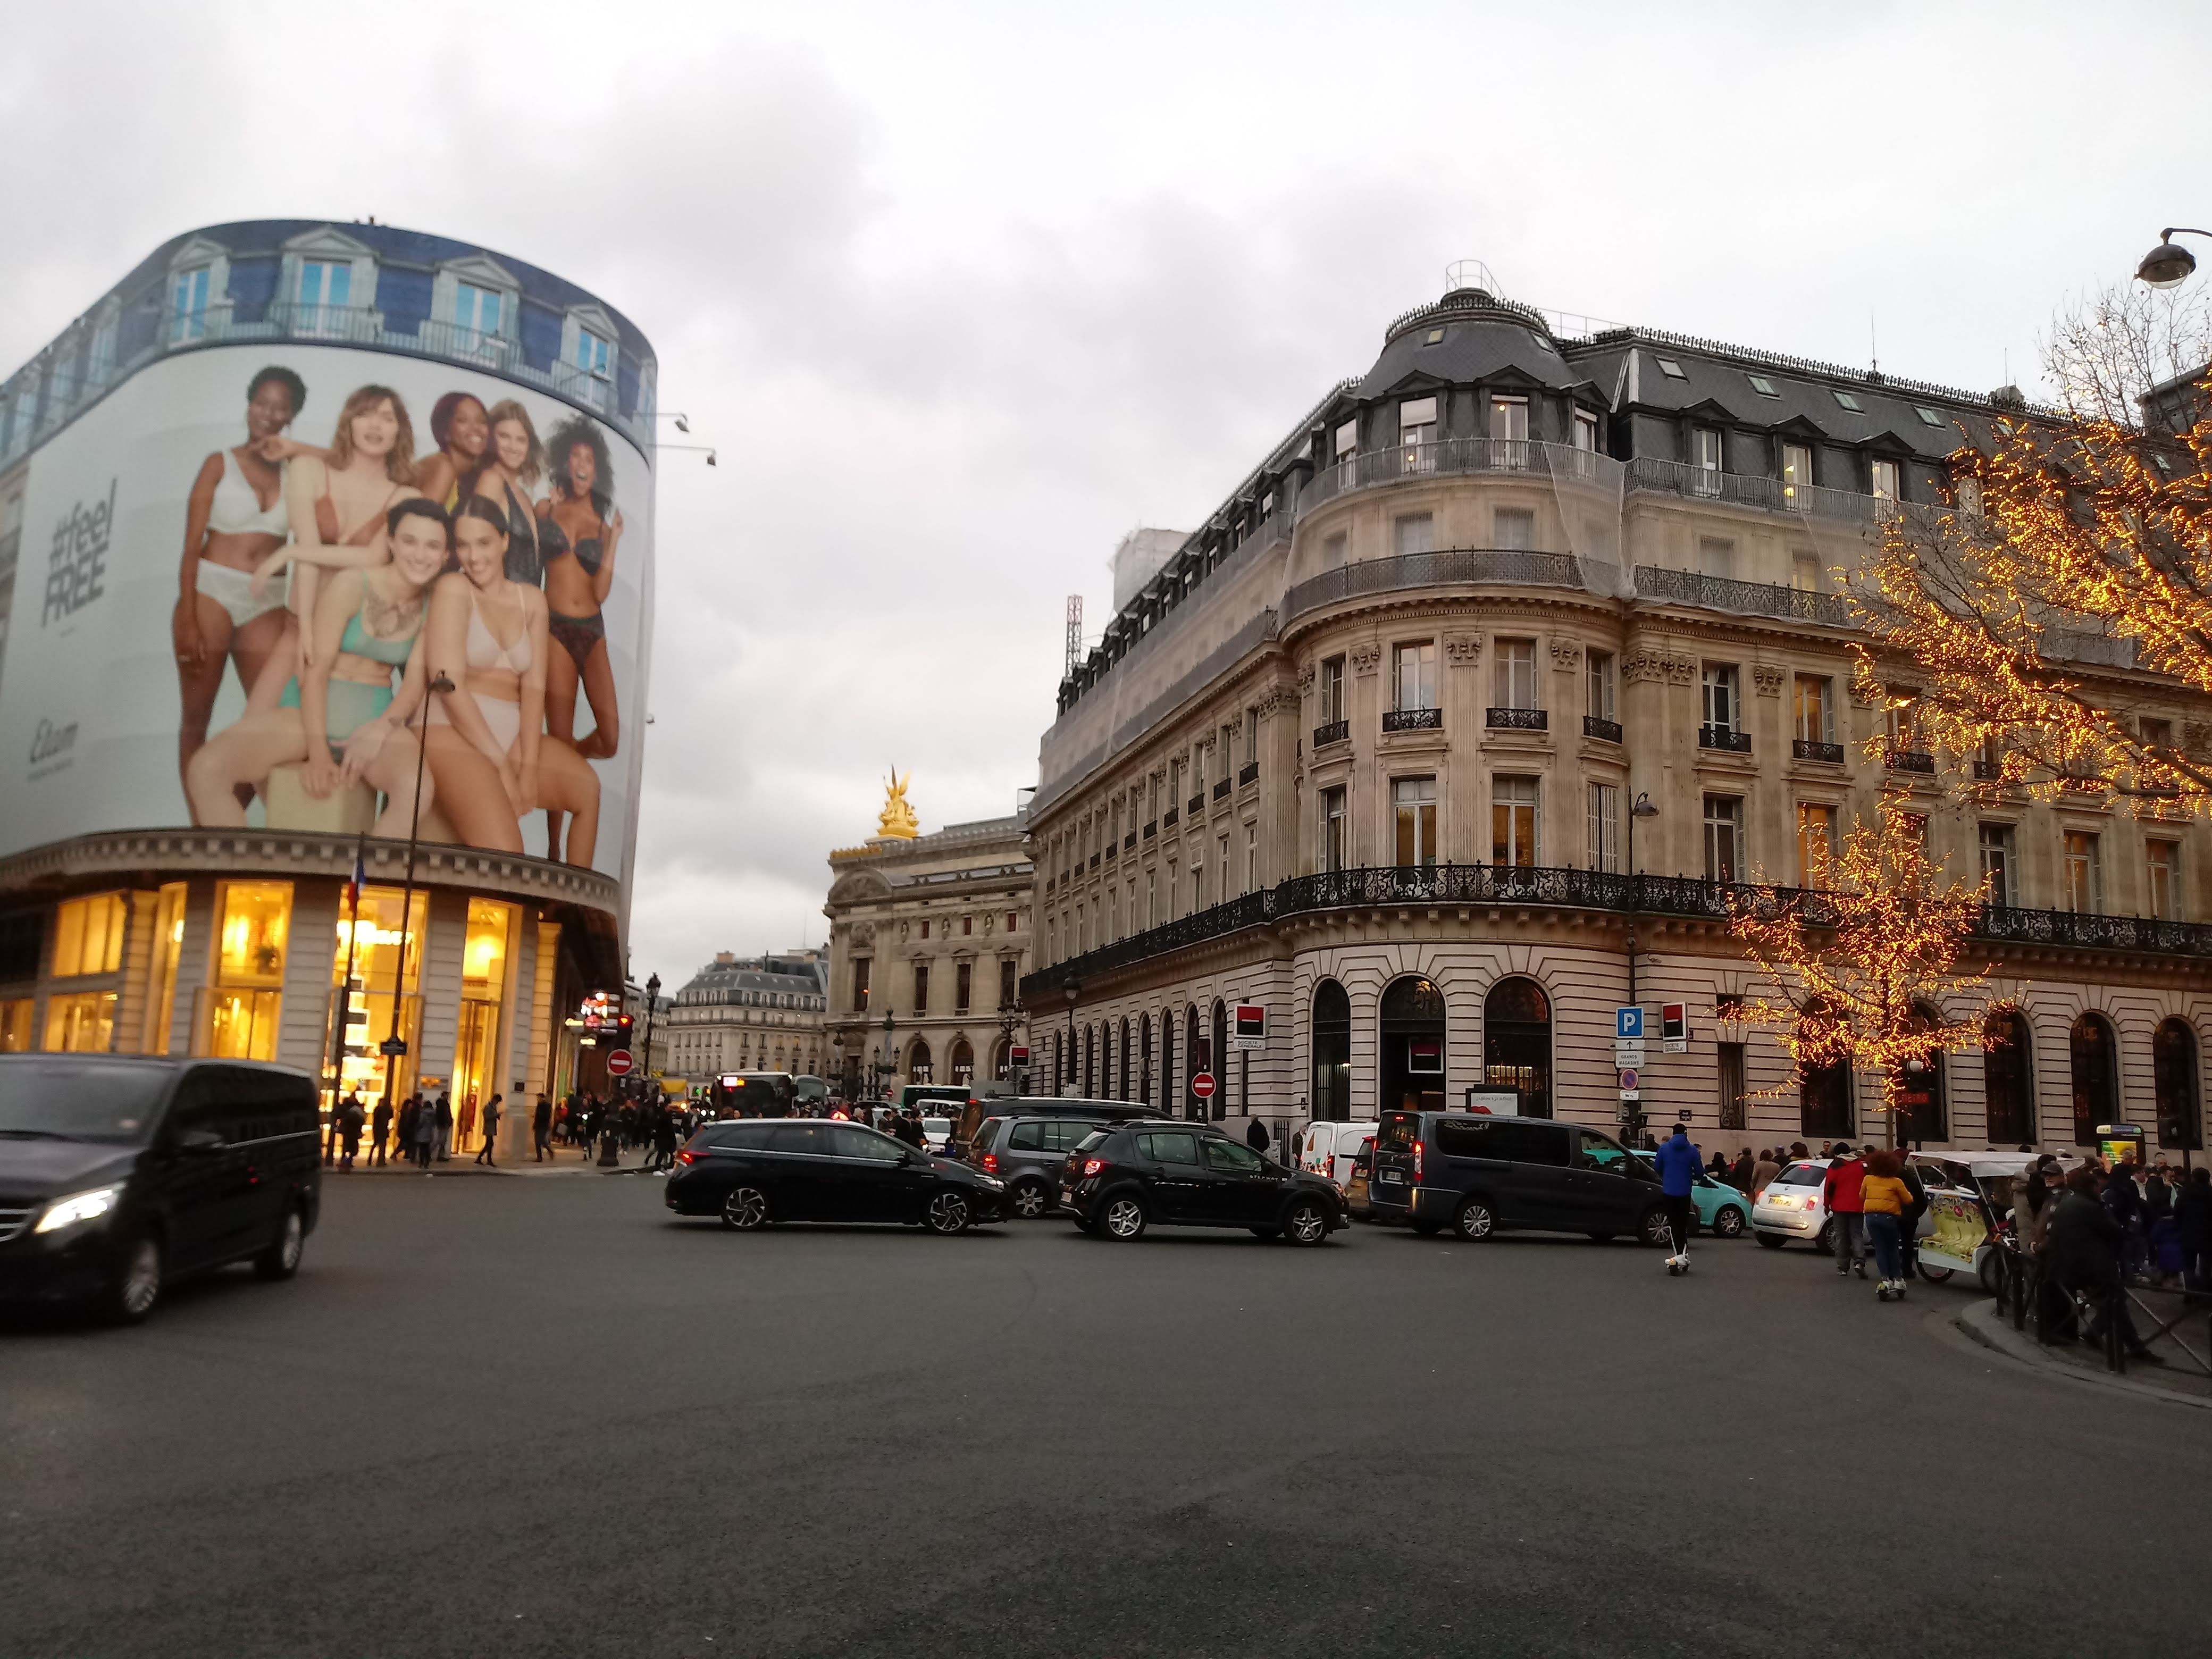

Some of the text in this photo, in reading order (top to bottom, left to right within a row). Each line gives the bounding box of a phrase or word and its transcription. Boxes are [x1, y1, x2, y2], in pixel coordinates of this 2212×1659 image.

[49, 477, 117, 567] #feel
[41, 541, 110, 628] FREE
[1623, 1013, 1636, 1032] P
